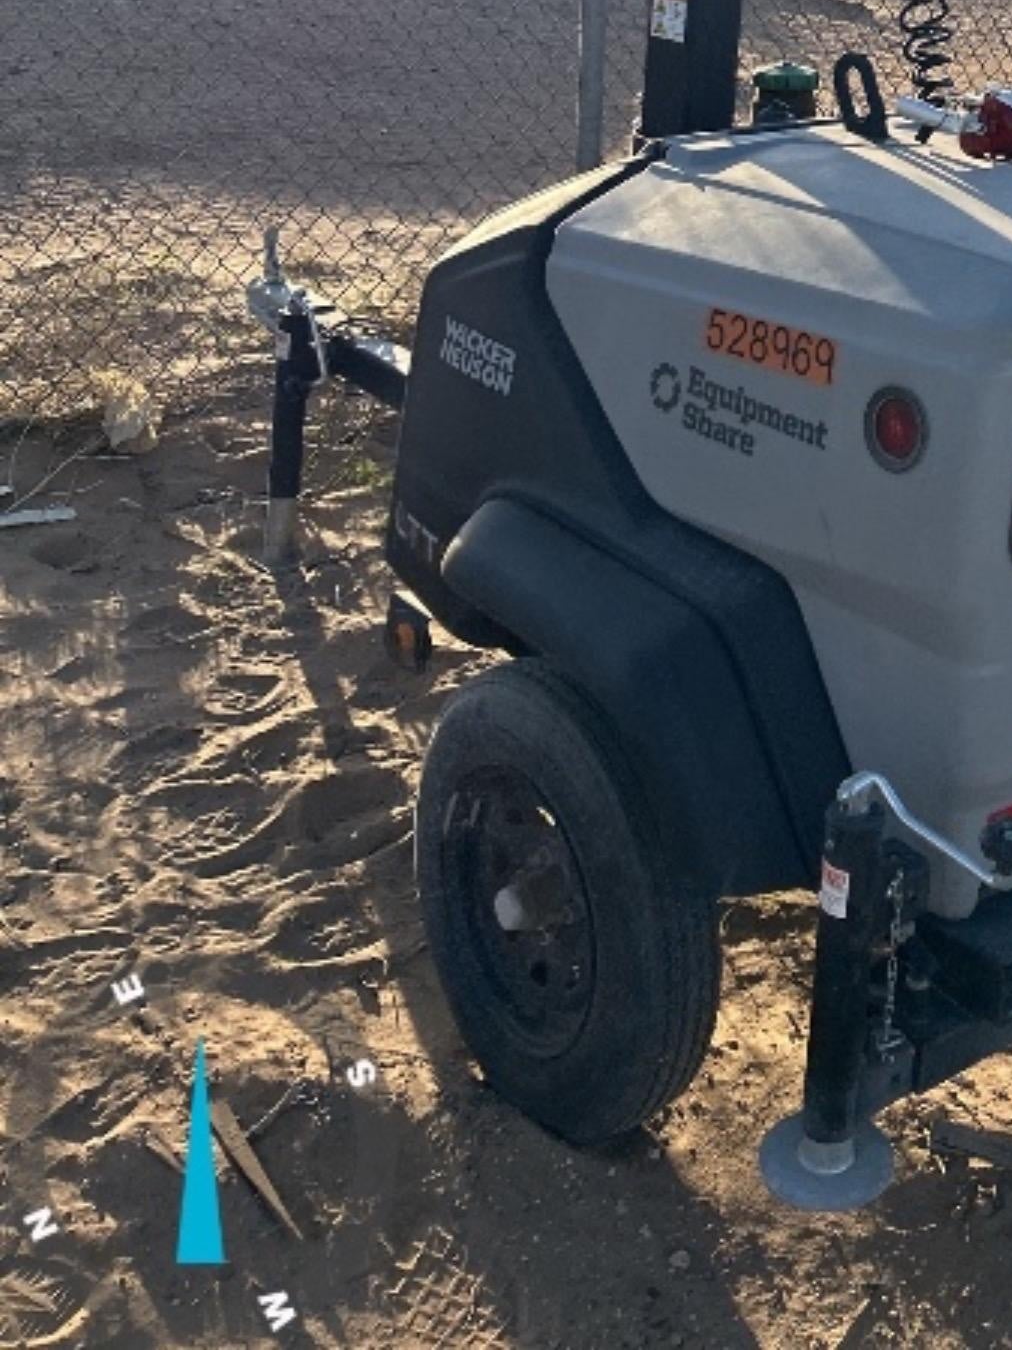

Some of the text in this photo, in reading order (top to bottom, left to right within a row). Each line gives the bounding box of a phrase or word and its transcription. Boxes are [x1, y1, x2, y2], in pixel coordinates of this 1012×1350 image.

[440, 338, 514, 397] NEUSON
[445, 314, 517, 372] WACKER
[706, 308, 836, 385] 528969
[682, 402, 756, 456] Share
[686, 365, 829, 450] Equipment
